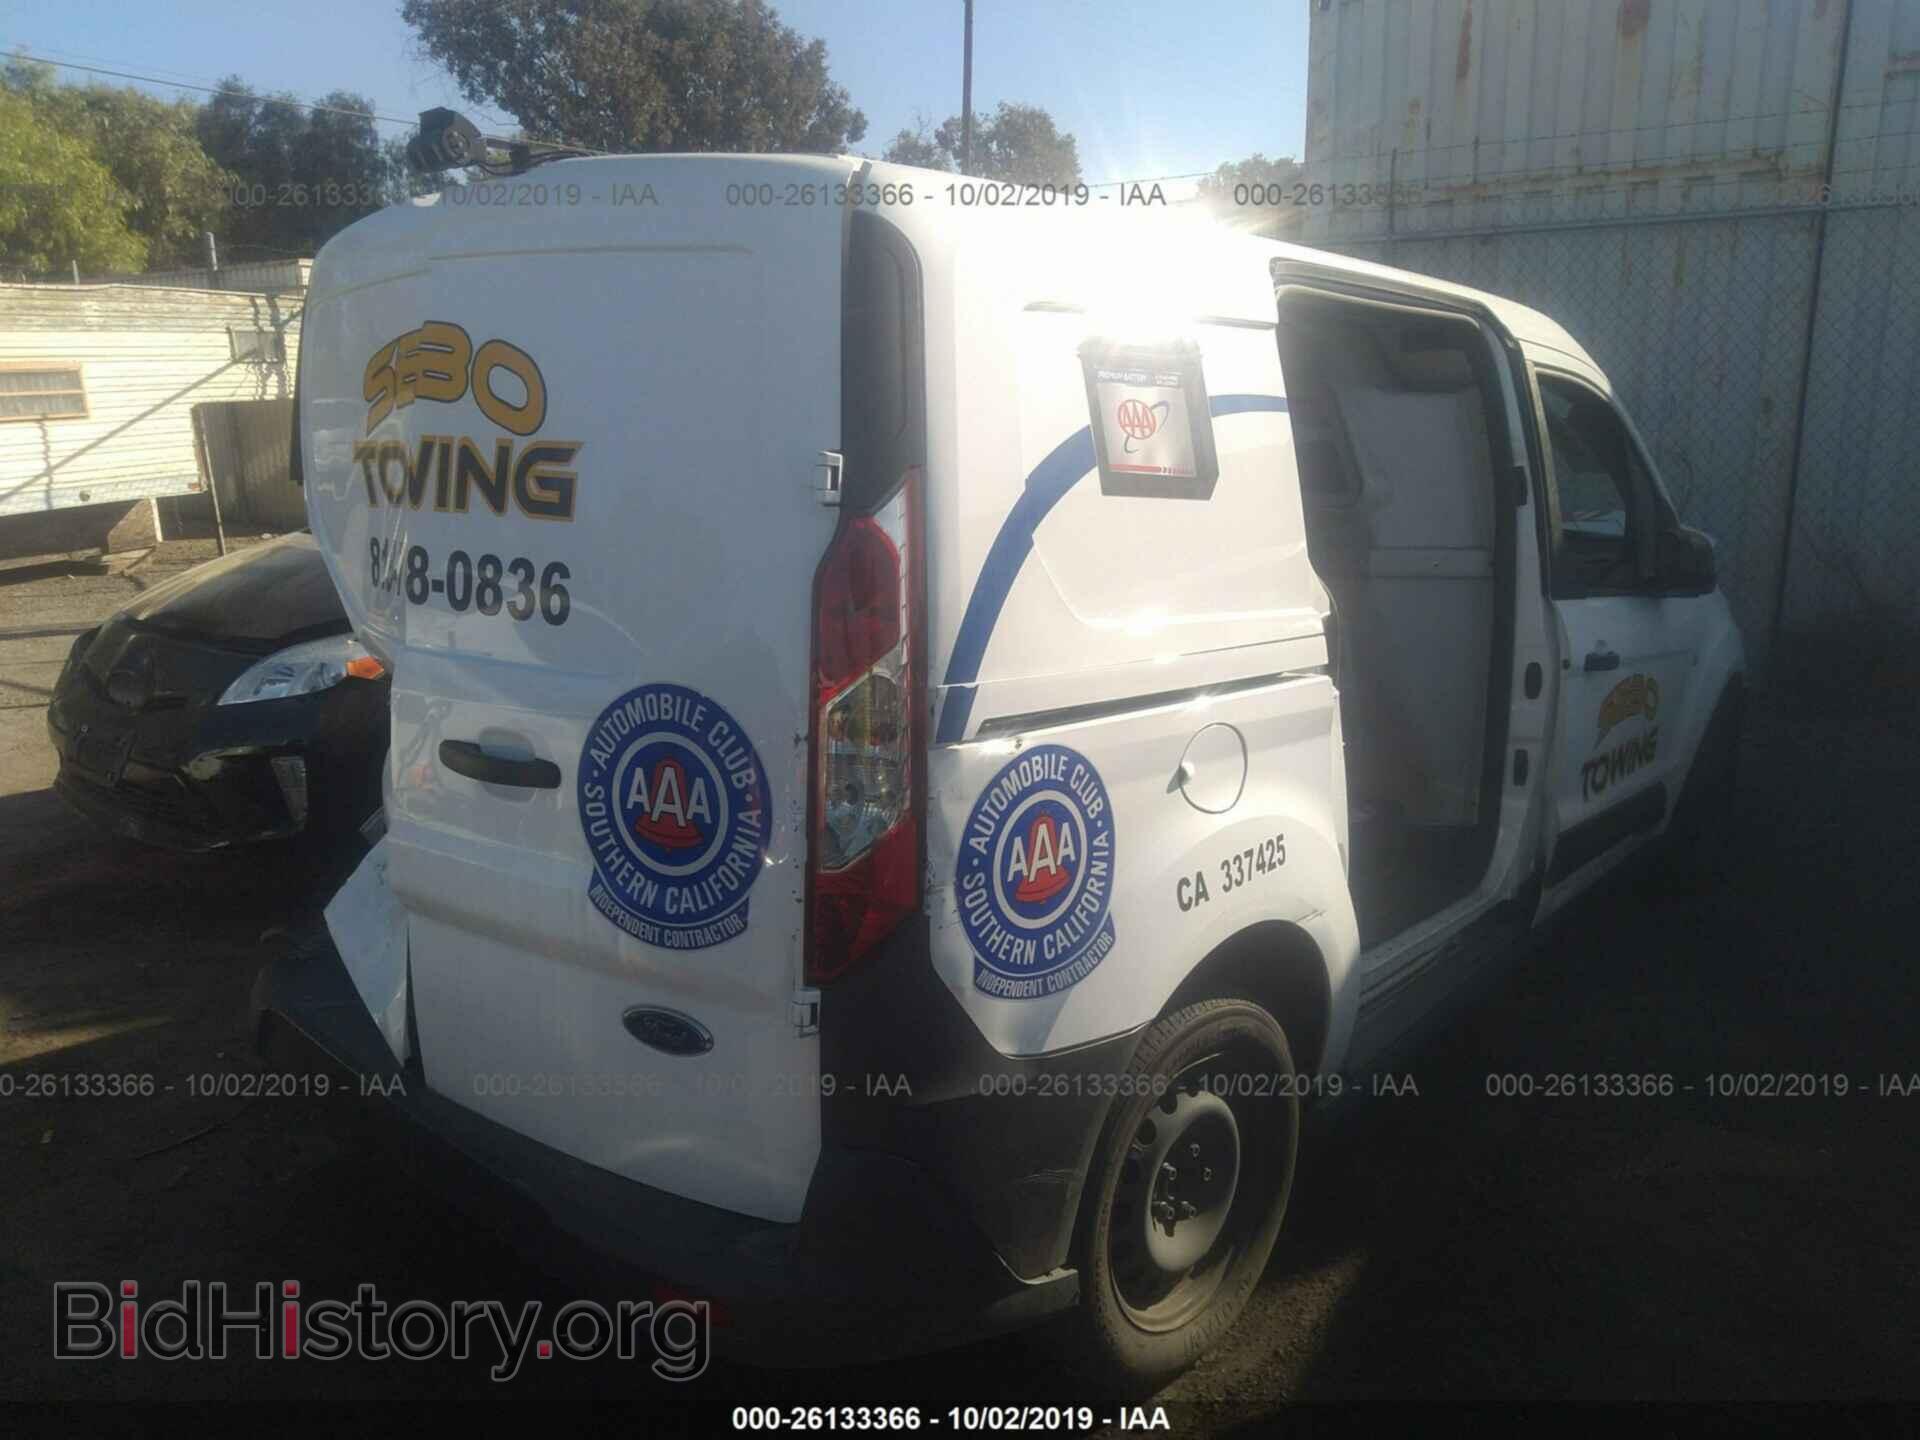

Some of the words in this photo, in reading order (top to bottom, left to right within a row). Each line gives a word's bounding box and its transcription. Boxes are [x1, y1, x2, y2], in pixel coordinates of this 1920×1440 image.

[590, 693, 707, 771] AUTOMOBILE
[707, 721, 757, 789] CLUB
[627, 767, 712, 828] AAA
[969, 754, 1069, 856] AUTOMOBILE
[1071, 763, 1104, 820] CLUB
[584, 782, 660, 909] SOUTHERN
[665, 808, 762, 915] CALIFORNIA
[1007, 822, 1076, 883] AAA
[1176, 872, 1210, 913] CA
[1221, 834, 1286, 893] 337425
[590, 886, 661, 944] INDEPENDENT
[663, 912, 745, 949] CONTRACTOR
[963, 872, 1036, 966] SOUTHERN
[1043, 830, 1109, 960] CALIFORNIA
[977, 969, 1047, 998] INDEPENDENT
[1047, 931, 1114, 994] CONTRACTOR
